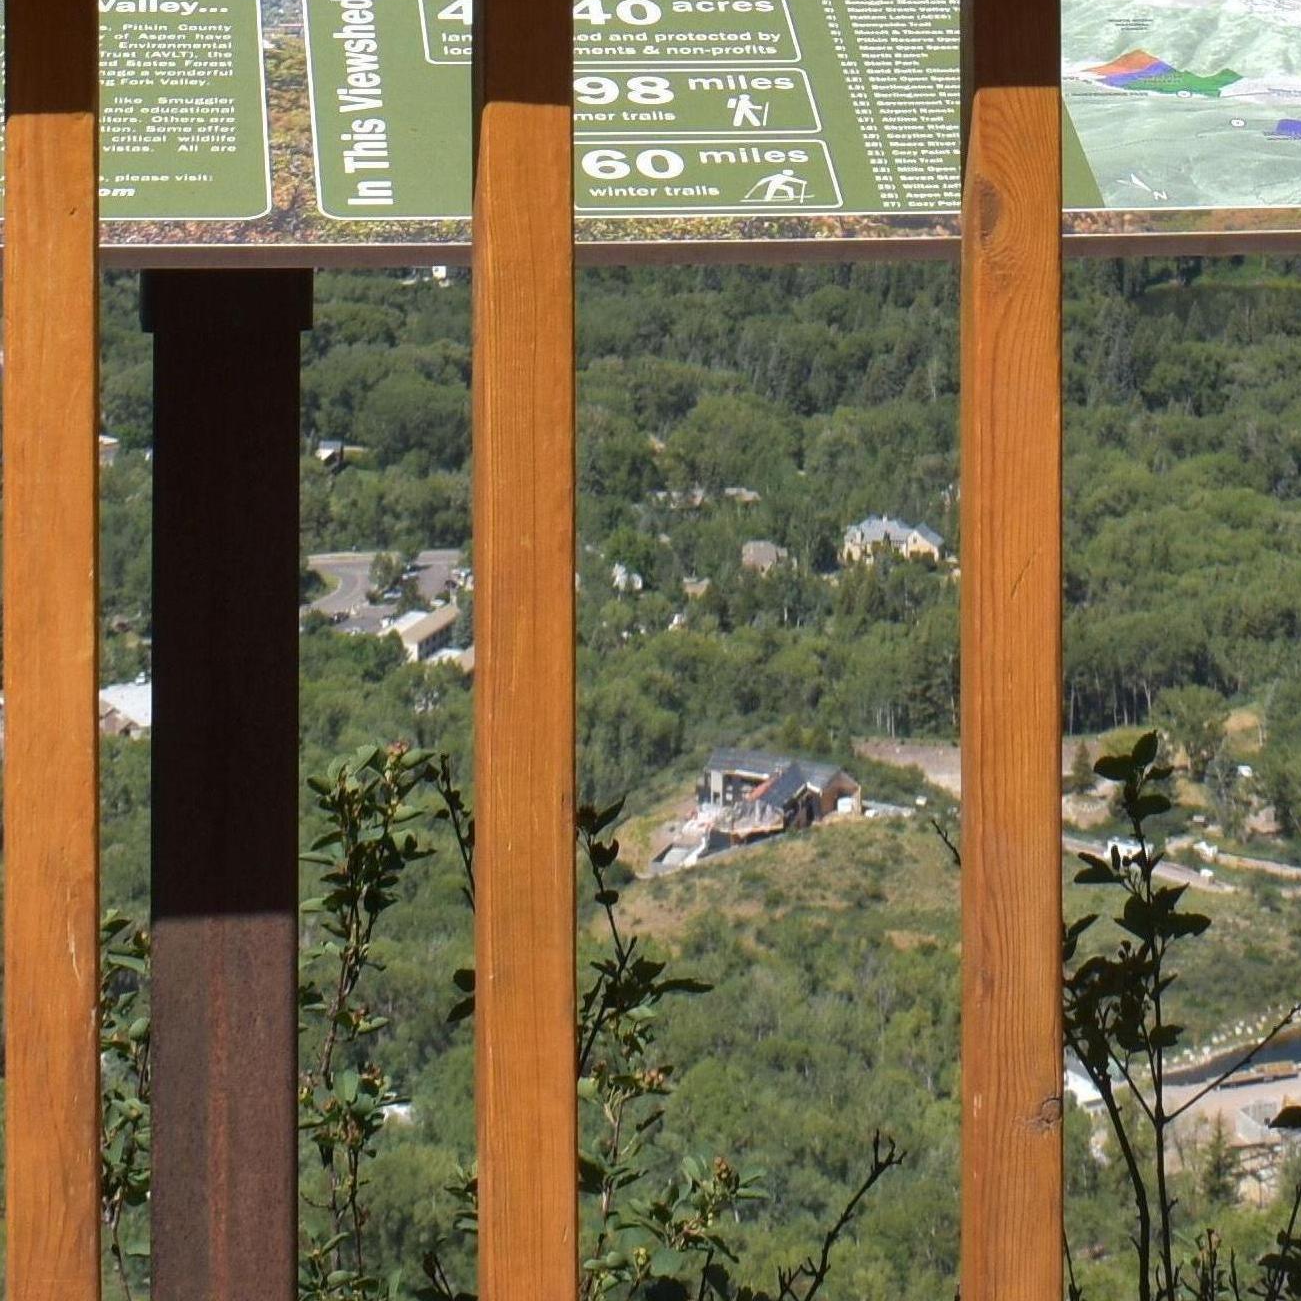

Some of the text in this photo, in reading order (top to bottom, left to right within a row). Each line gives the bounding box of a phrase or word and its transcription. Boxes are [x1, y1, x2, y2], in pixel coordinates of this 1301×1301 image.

[672, 0, 774, 12] acres
[441, 32, 473, 42] lan
[609, 32, 648, 41] and
[655, 32, 752, 42] protected
[758, 32, 781, 42] by
[443, 46, 473, 55] loc
[642, 46, 660, 55] &
[666, 45, 778, 55] non-profits
[688, 75, 795, 90] miles
[158, 97, 235, 105] Smuggler
[104, 106, 235, 114] and educational
[622, 111, 676, 121] trails
[341, 118, 391, 173] This
[581, 148, 809, 179] 60 miles
[115, 174, 169, 182] please
[174, 174, 214, 182] visit:
[347, 181, 393, 205] In
[589, 186, 720, 197] winter trails
